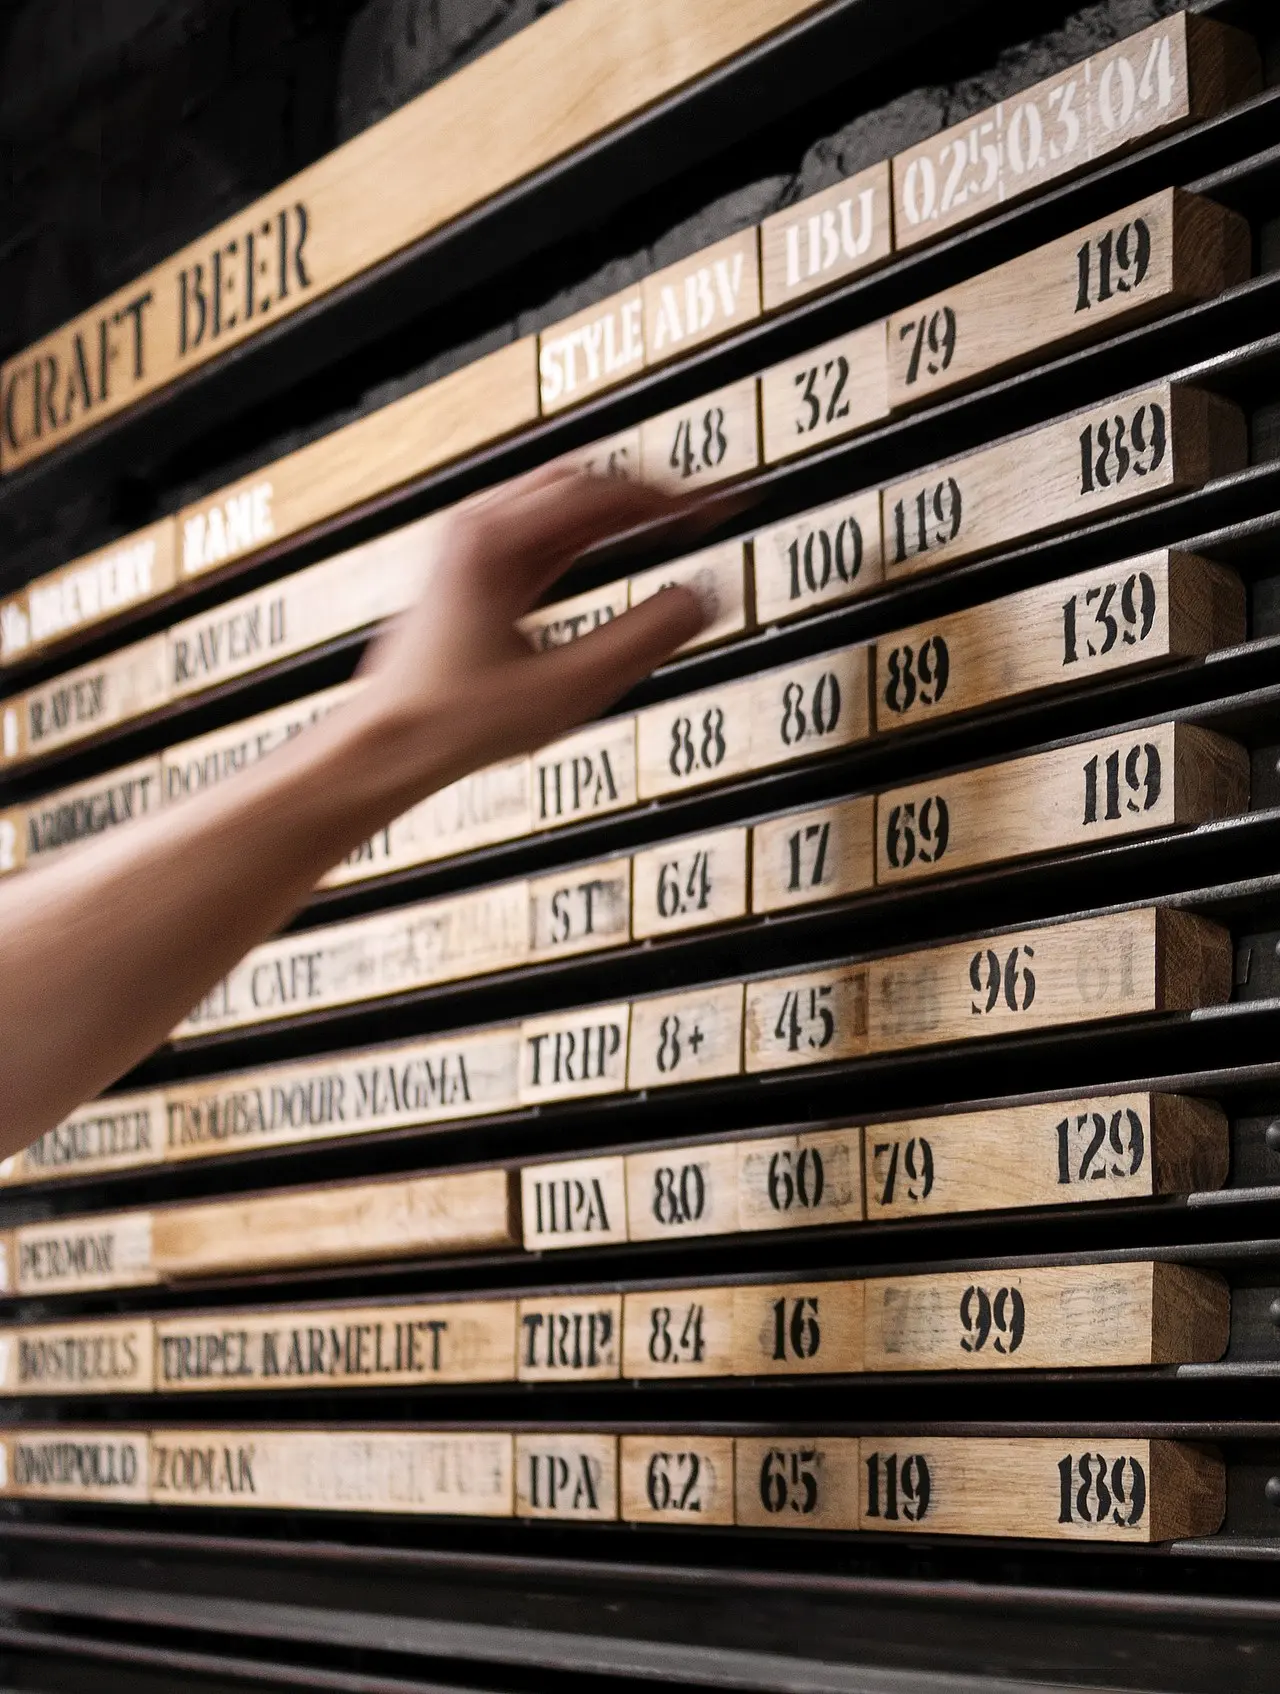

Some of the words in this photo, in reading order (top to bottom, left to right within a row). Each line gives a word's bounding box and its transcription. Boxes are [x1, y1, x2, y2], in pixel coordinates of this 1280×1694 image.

[786, 189, 875, 287] IBU
[4, 290, 153, 450] CRAFT
[176, 201, 312, 357] BEER
[654, 253, 744, 349] ABV
[899, 306, 957, 386] 79
[1073, 217, 1152, 314] 119
[540, 298, 644, 402] STYLE
[794, 355, 850, 434] 32
[669, 407, 728, 479] 4.8
[892, 476, 963, 566] 119
[1078, 402, 1167, 496] 189
[786, 515, 864, 601] 100
[172, 605, 263, 684] RAVEN
[884, 634, 950, 714] 89
[1061, 571, 1157, 667] 139
[668, 707, 727, 778] 8.8
[538, 749, 619, 819] IIPA
[885, 795, 951, 870] 69
[1082, 742, 1163, 826] 119
[656, 850, 713, 919] 6.4
[787, 821, 832, 894] 17
[551, 880, 602, 944] ST
[251, 951, 324, 1008] CAFE
[968, 944, 1037, 1016] 96
[527, 1022, 622, 1086] TRIP
[655, 1015, 705, 1073] 8+
[774, 985, 835, 1053] 45
[167, 1073, 345, 1147] TROUBADOUR
[355, 1053, 472, 1118] MAGMA
[767, 1146, 825, 1212] 60
[873, 1136, 935, 1206] 79
[1055, 1107, 1145, 1185] 129
[534, 1178, 611, 1234] IIPA
[160, 1327, 252, 1382] TRIPEL
[260, 1320, 449, 1379] KARMELIET
[523, 1310, 614, 1369] TRIP
[648, 1302, 706, 1364] 8.4
[771, 1295, 821, 1362] 16
[959, 1284, 1027, 1355] 99
[152, 1443, 257, 1494] ZODIAK
[528, 1453, 600, 1511] IPA
[759, 1449, 821, 1515] 65
[864, 1451, 933, 1522] 119
[1057, 1451, 1147, 1528] 189
